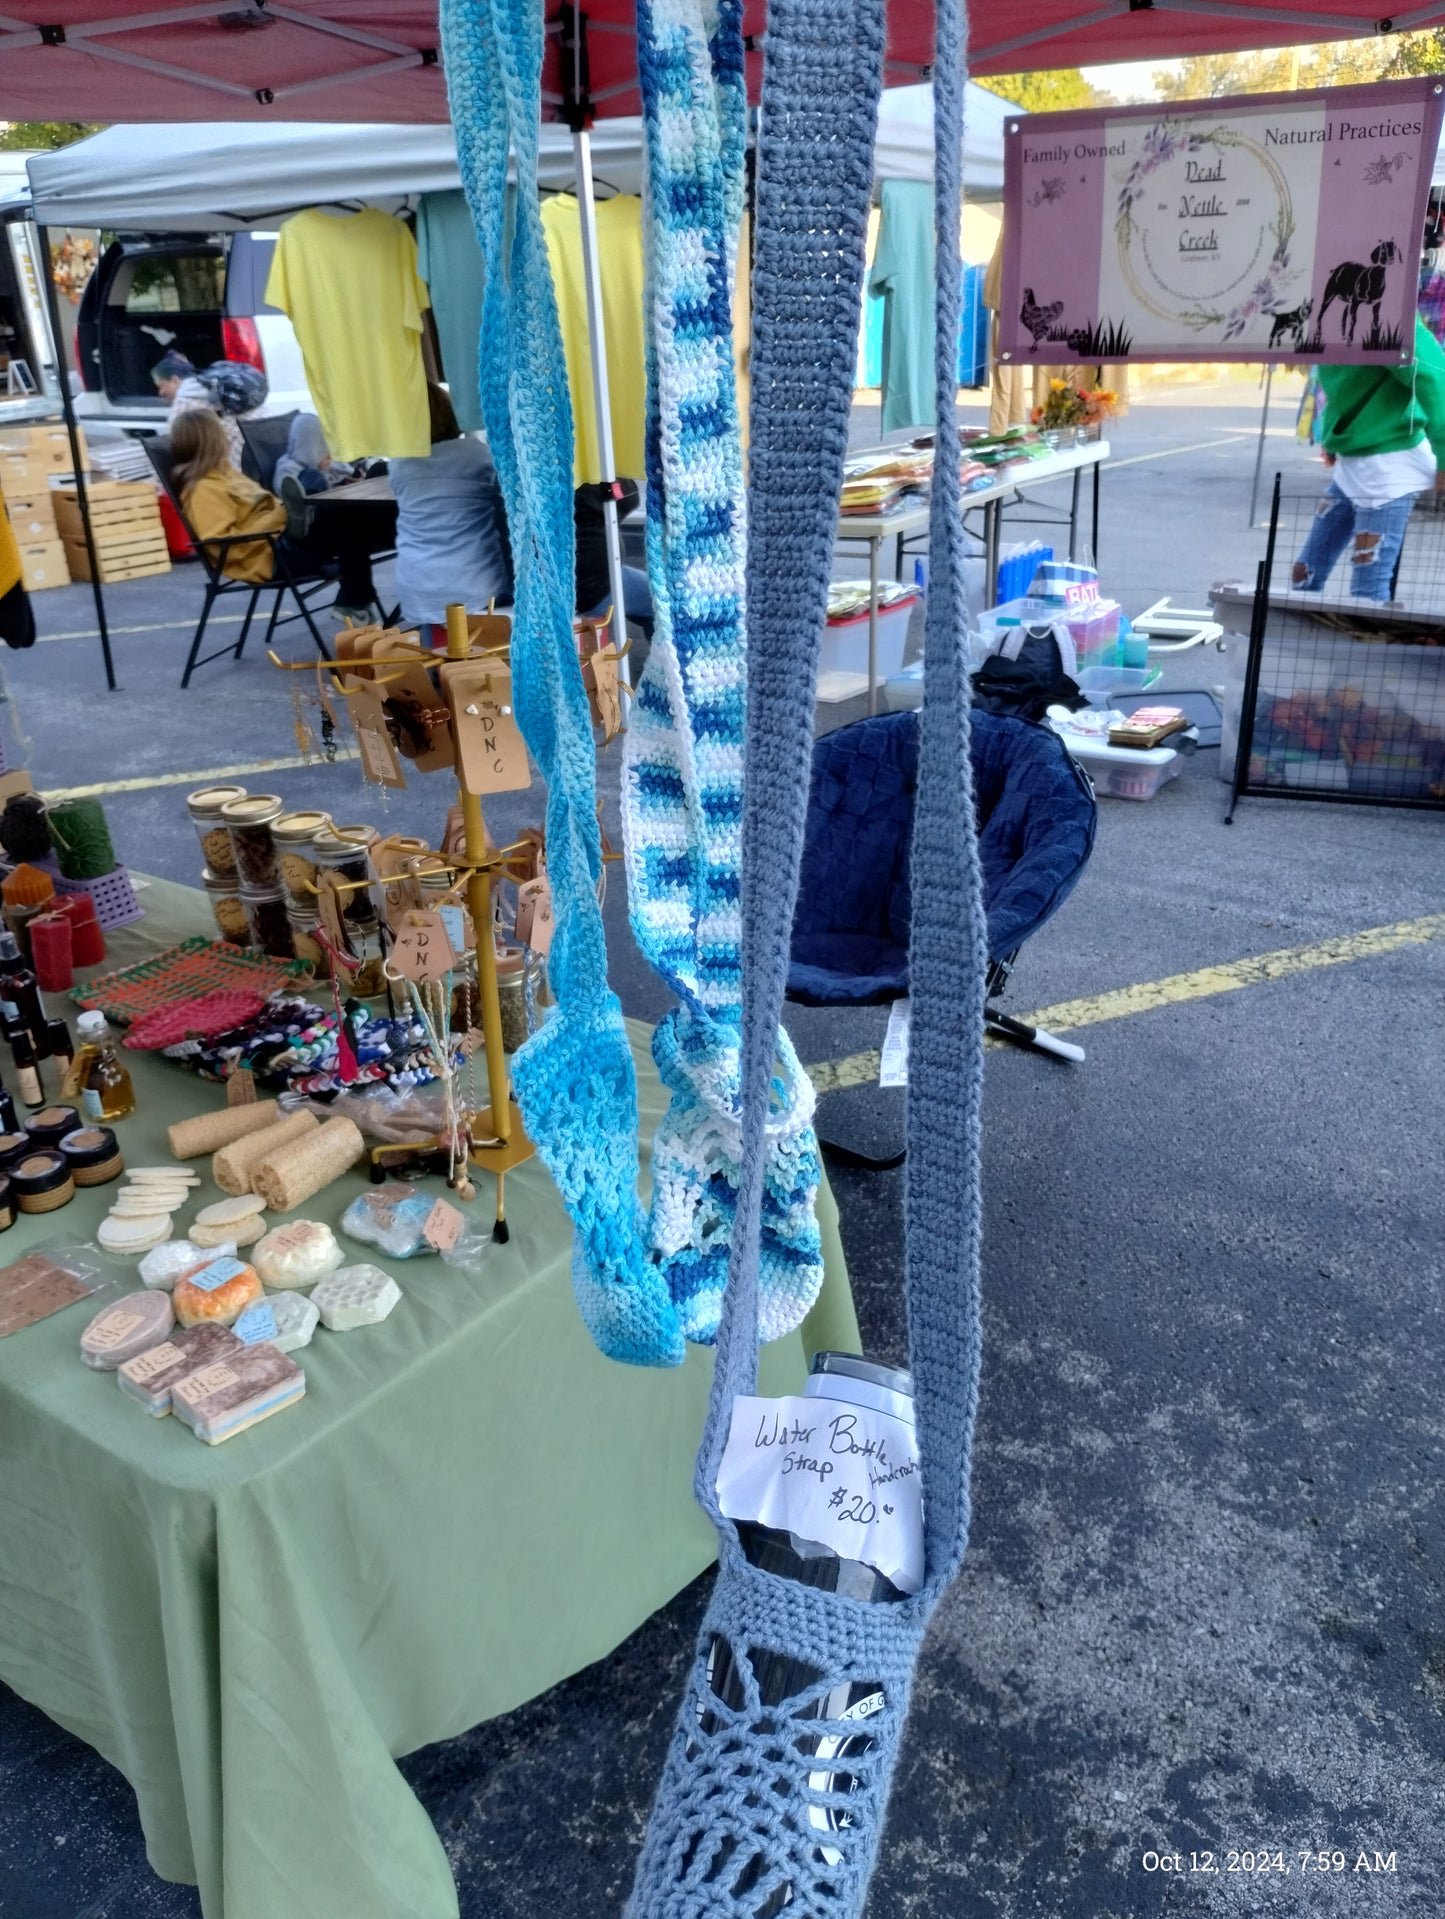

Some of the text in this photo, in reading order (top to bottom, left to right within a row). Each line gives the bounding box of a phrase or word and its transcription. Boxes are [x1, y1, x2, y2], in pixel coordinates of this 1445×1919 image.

[1264, 118, 1422, 146] Natural Practices
[1023, 139, 1125, 165] Family Owned
[1185, 159, 1224, 182] Dead
[1179, 228, 1218, 251] Creek
[755, 1412, 888, 1465] Water Bottle
[782, 1451, 834, 1482] Strap
[859, 1698, 874, 1714] OF
